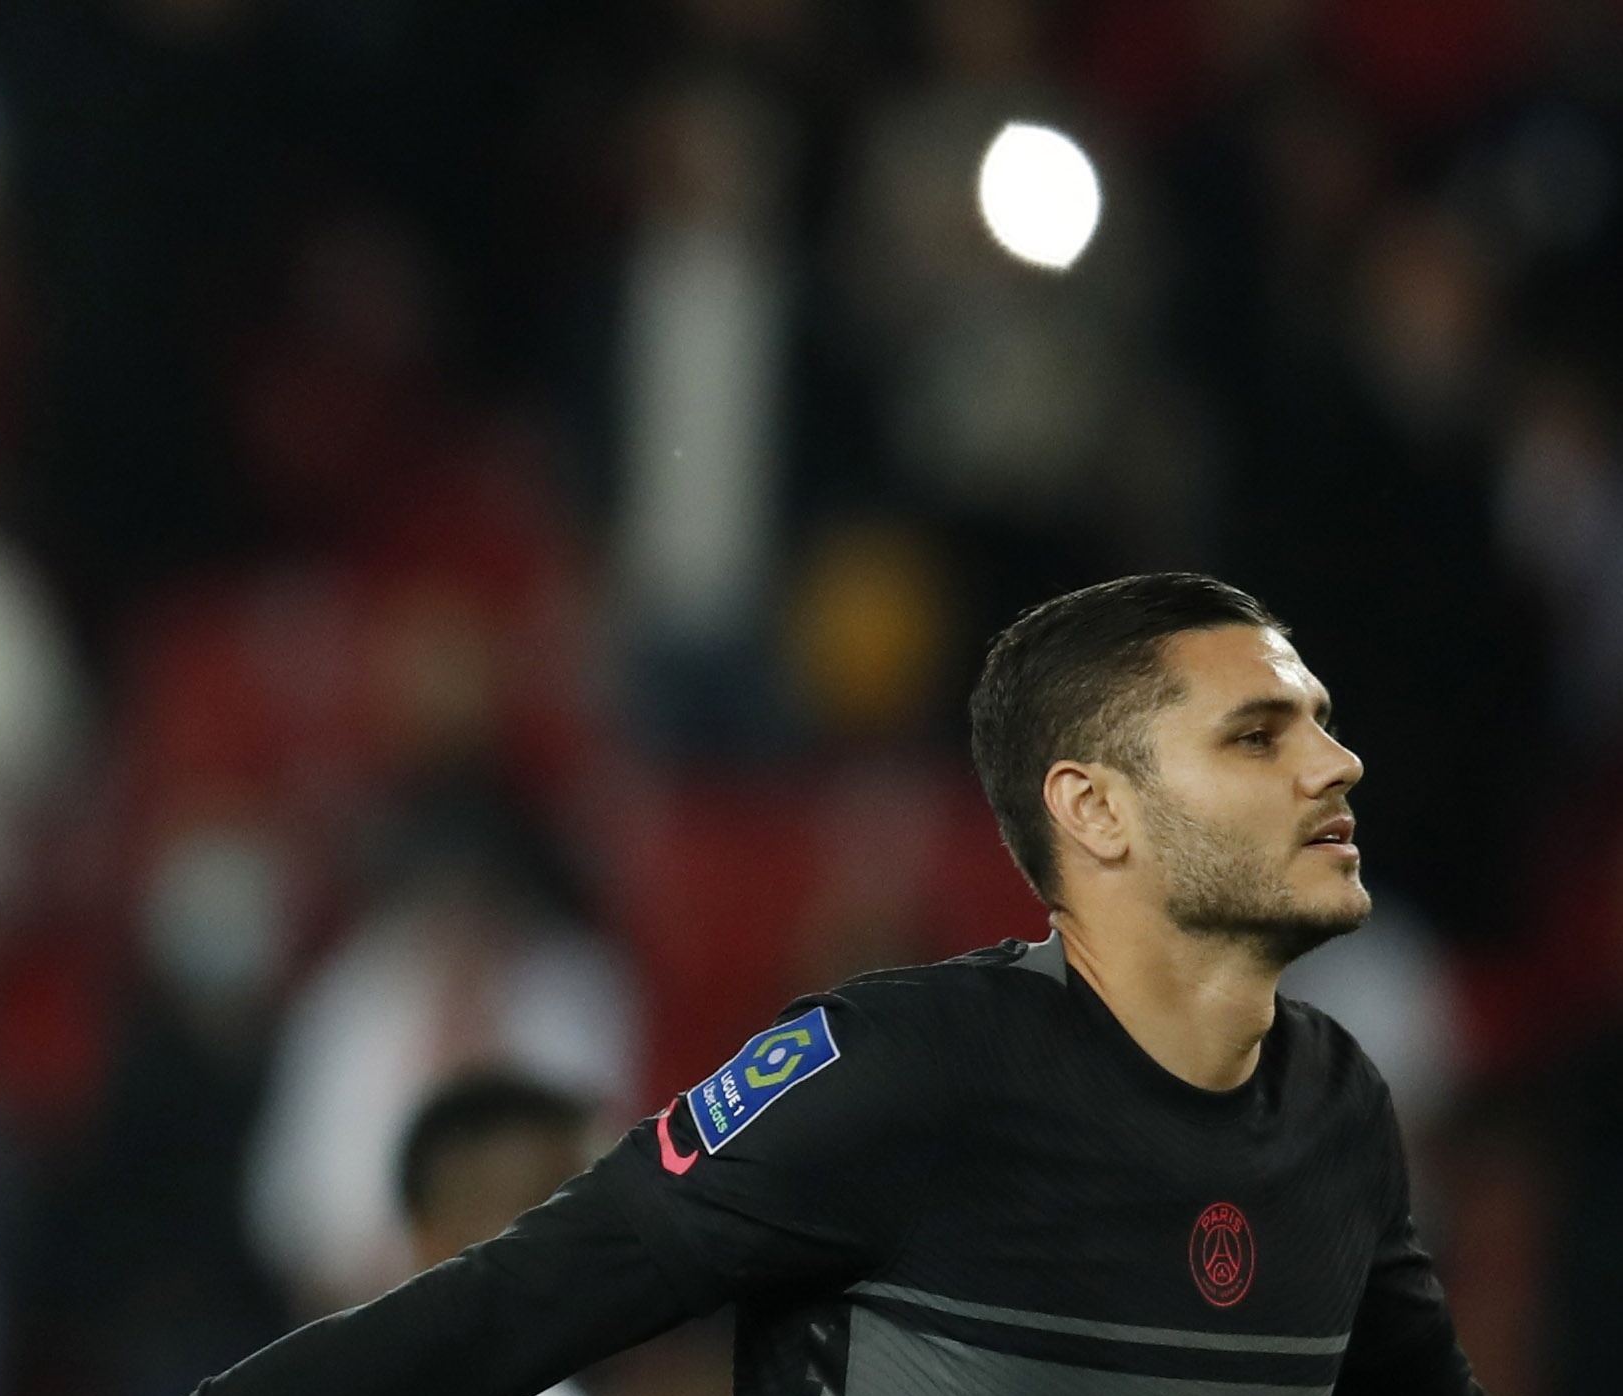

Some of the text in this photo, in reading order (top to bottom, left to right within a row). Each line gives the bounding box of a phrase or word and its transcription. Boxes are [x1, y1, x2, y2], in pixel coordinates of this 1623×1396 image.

[720, 1069, 746, 1117] LIGUE 1
[708, 1101, 729, 1134] Eats
[1200, 1207, 1243, 1233] PARIS
